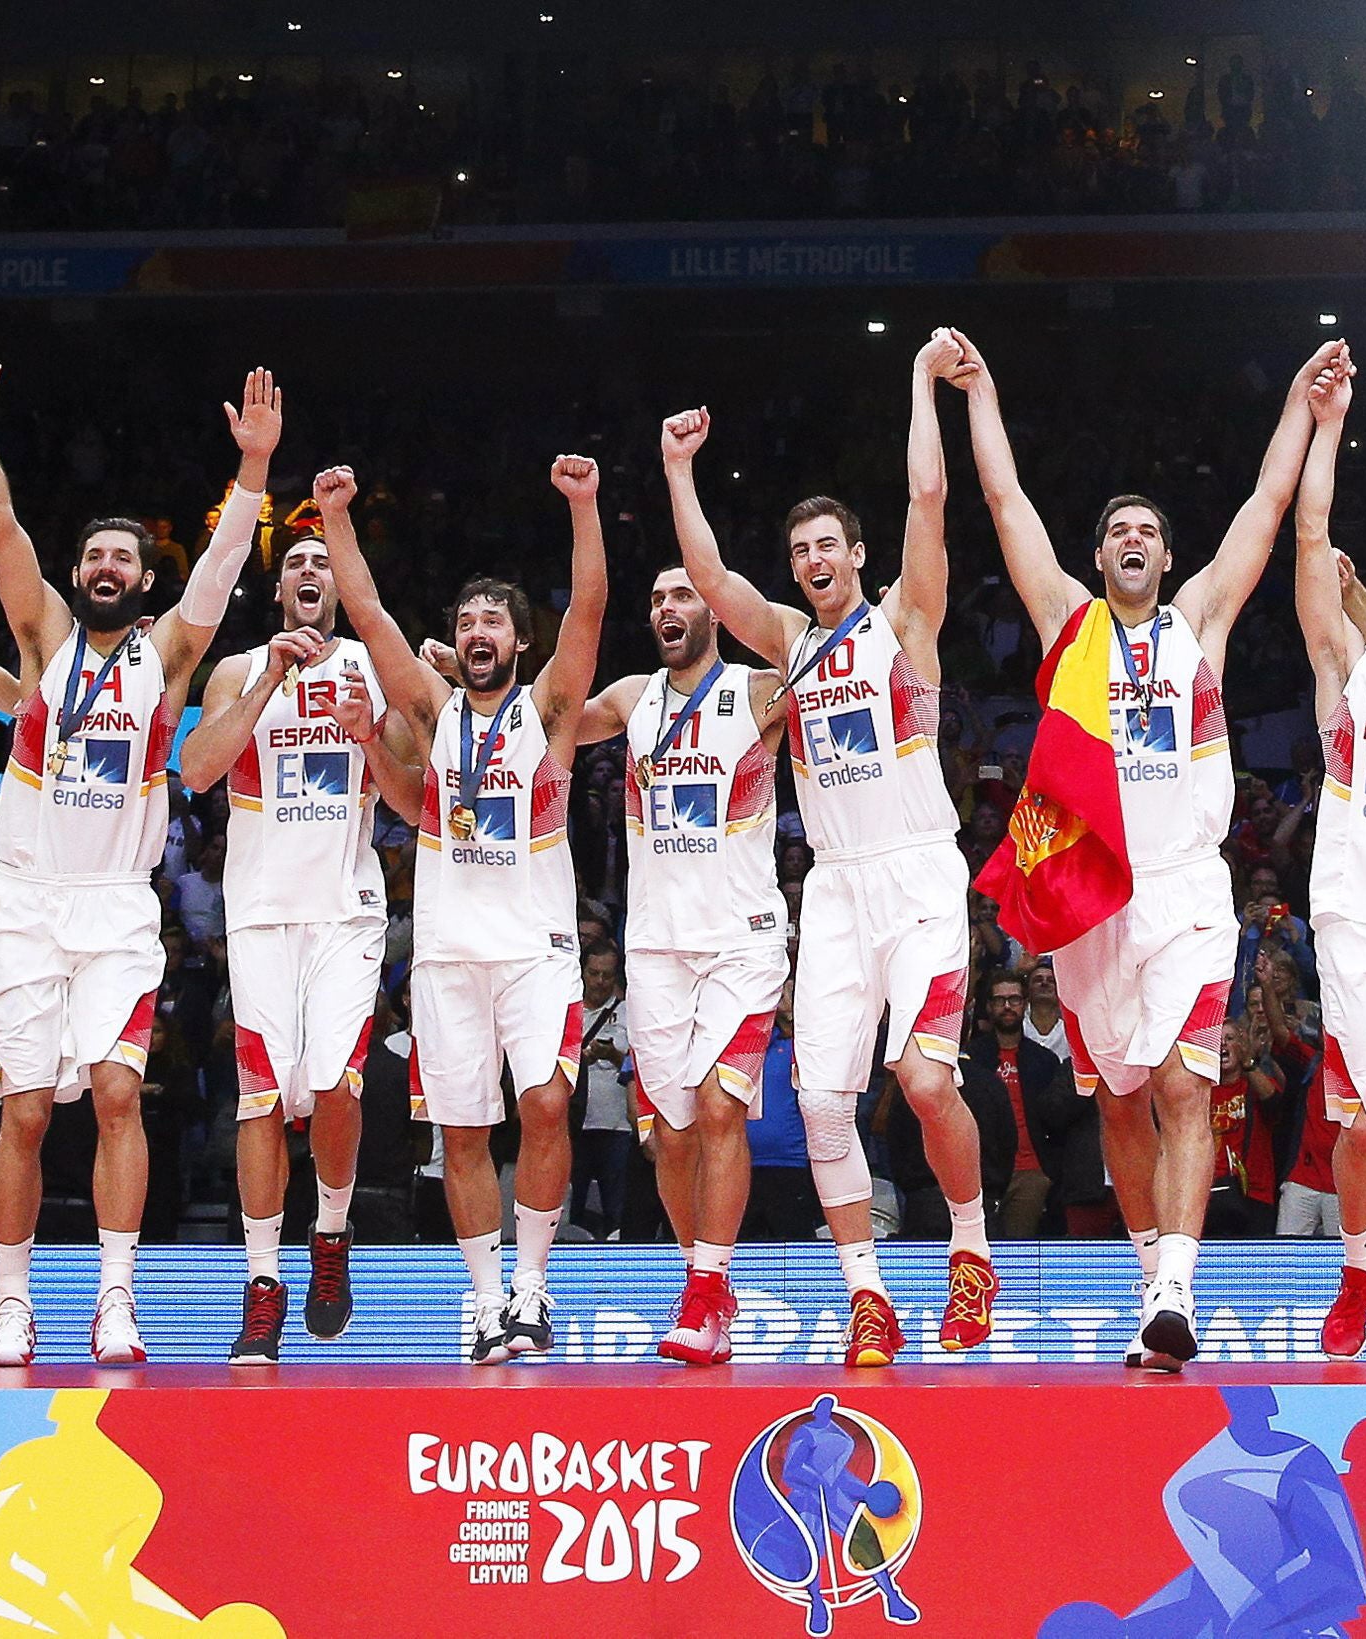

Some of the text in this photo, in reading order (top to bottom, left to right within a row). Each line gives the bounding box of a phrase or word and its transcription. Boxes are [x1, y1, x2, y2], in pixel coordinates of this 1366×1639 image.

[670, 241, 916, 276] LILLE MÉTROPOLE
[817, 637, 855, 683] 10
[296, 680, 337, 719] 13
[798, 680, 879, 713] ESPAÑA
[1109, 679, 1181, 702] SPAÑA
[269, 722, 358, 748] ESPAÑA
[653, 753, 726, 777] SPAÑA
[818, 762, 883, 789] endesa
[1117, 759, 1178, 783] ndesa
[53, 788, 125, 810] endesa
[276, 801, 347, 823] endesa
[452, 846, 516, 866] endesa
[653, 834, 717, 854] endesa
[408, 1432, 712, 1495] EUROBASKET
[466, 1500, 530, 1520] FRANCE
[458, 1521, 530, 1541] CROATIA
[539, 1499, 701, 1584] 2015
[449, 1543, 529, 1563] GERMANY
[468, 1564, 529, 1584] LATVIA
